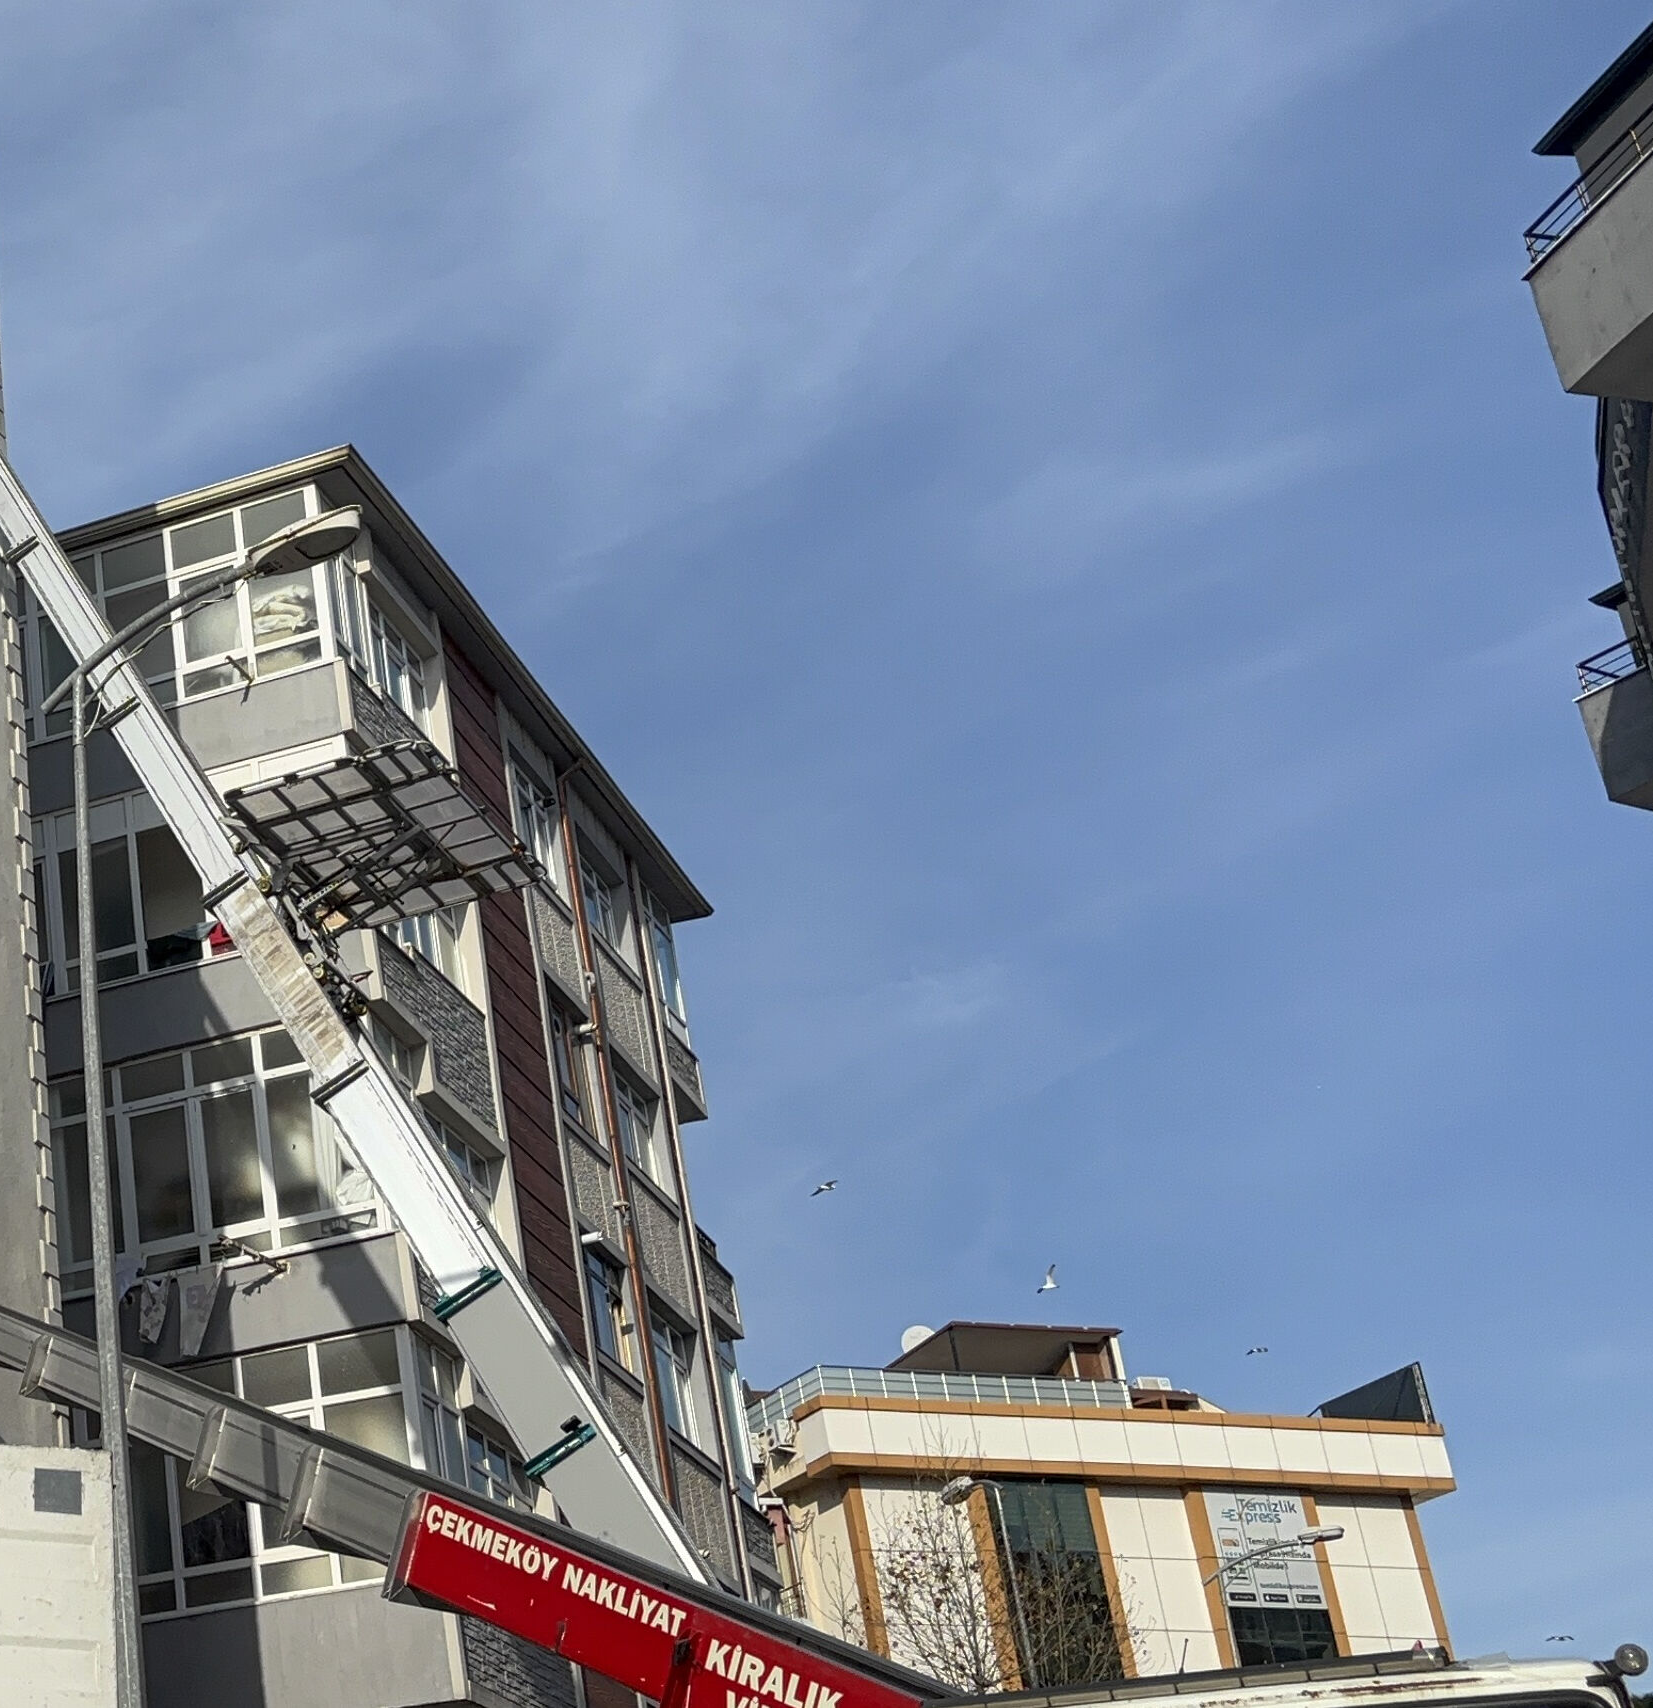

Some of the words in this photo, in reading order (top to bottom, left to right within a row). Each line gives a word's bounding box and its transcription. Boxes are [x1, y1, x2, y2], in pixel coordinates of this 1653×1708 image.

[1237, 1498, 1297, 1514] Temizlik
[426, 1504, 559, 1581] ÇEKMEKÖY
[561, 1562, 687, 1637] NAKLİYAT
[704, 1638, 845, 1708] KİRALIK
